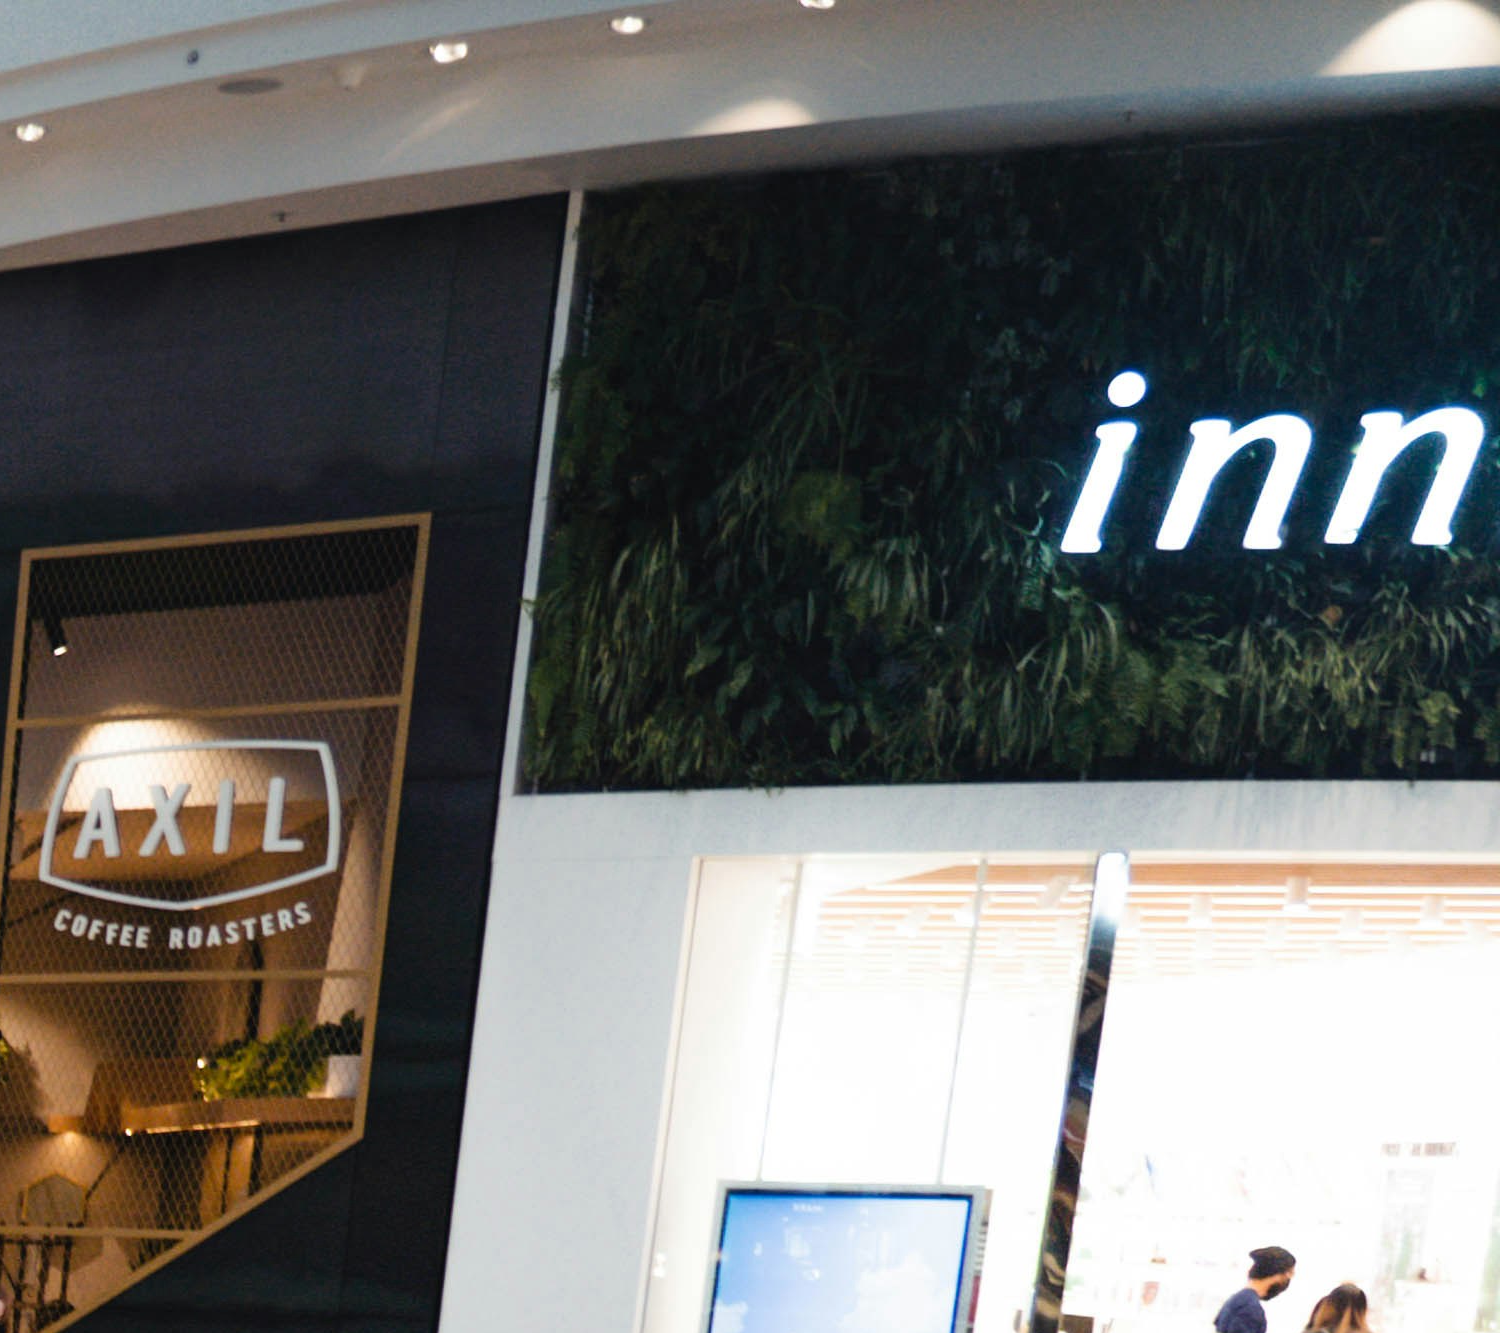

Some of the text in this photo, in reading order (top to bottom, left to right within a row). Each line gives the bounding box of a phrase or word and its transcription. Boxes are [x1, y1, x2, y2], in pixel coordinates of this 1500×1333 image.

[1060, 370, 1485, 554] inn
[72, 776, 304, 860] AXIL
[53, 901, 312, 950] COFFEE ROASTERS
